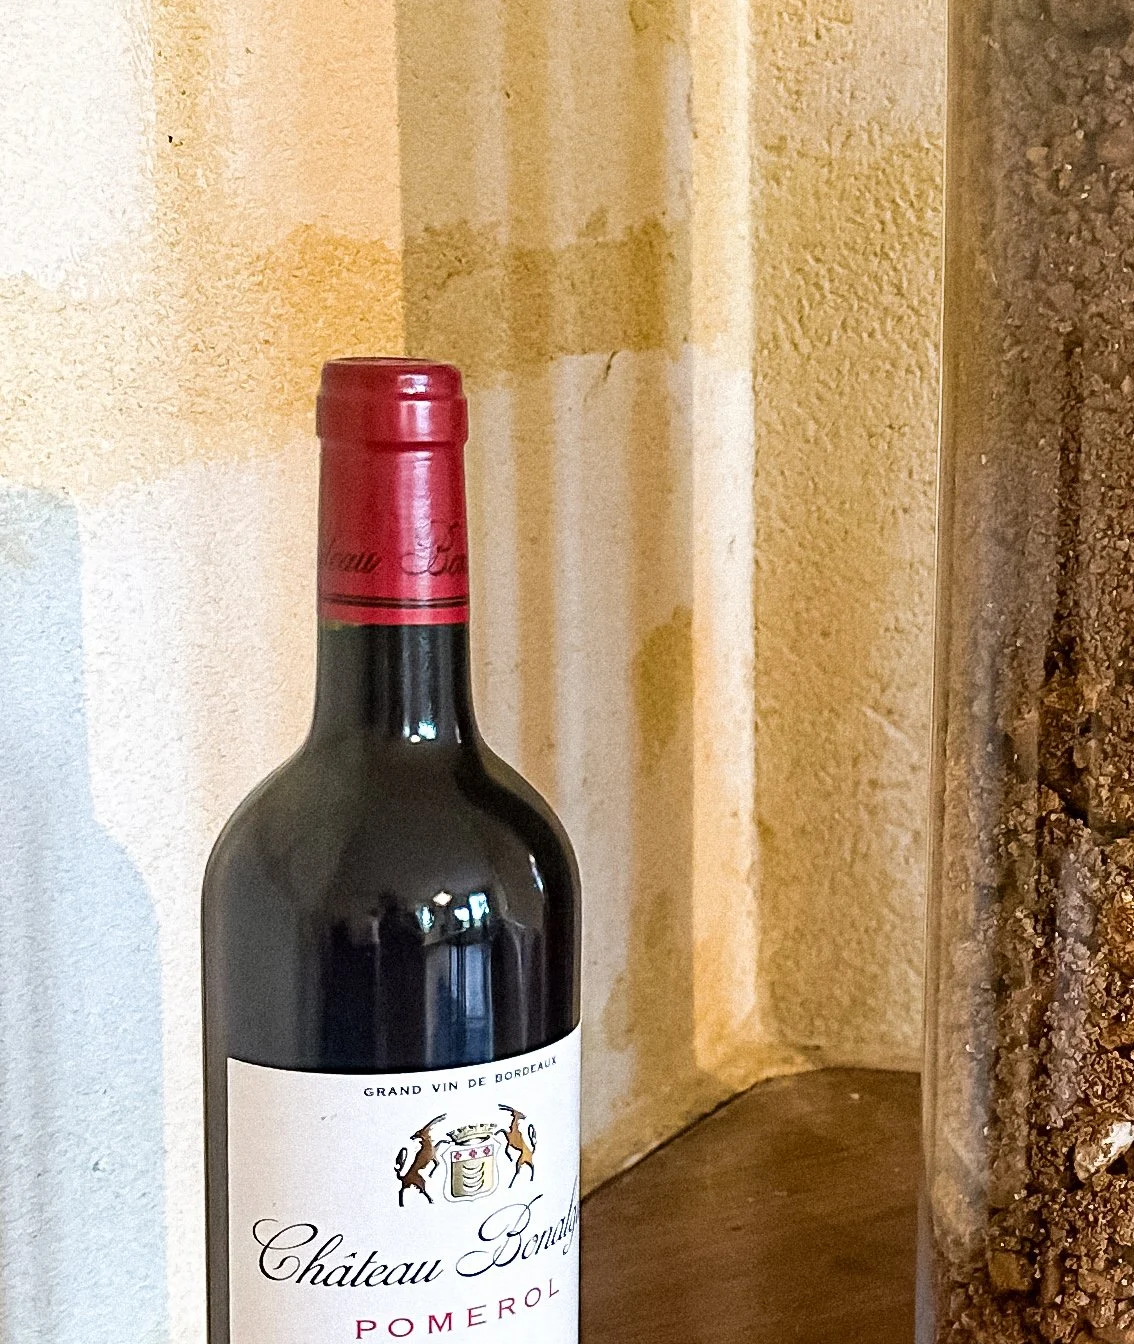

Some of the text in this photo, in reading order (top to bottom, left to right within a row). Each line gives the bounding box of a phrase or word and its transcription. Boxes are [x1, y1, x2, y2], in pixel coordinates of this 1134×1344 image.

[364, 1056, 558, 1097] GRAND VIN DE BORDEAUX
[252, 1218, 444, 1288] Château
[355, 1276, 561, 1340] POMEROL
